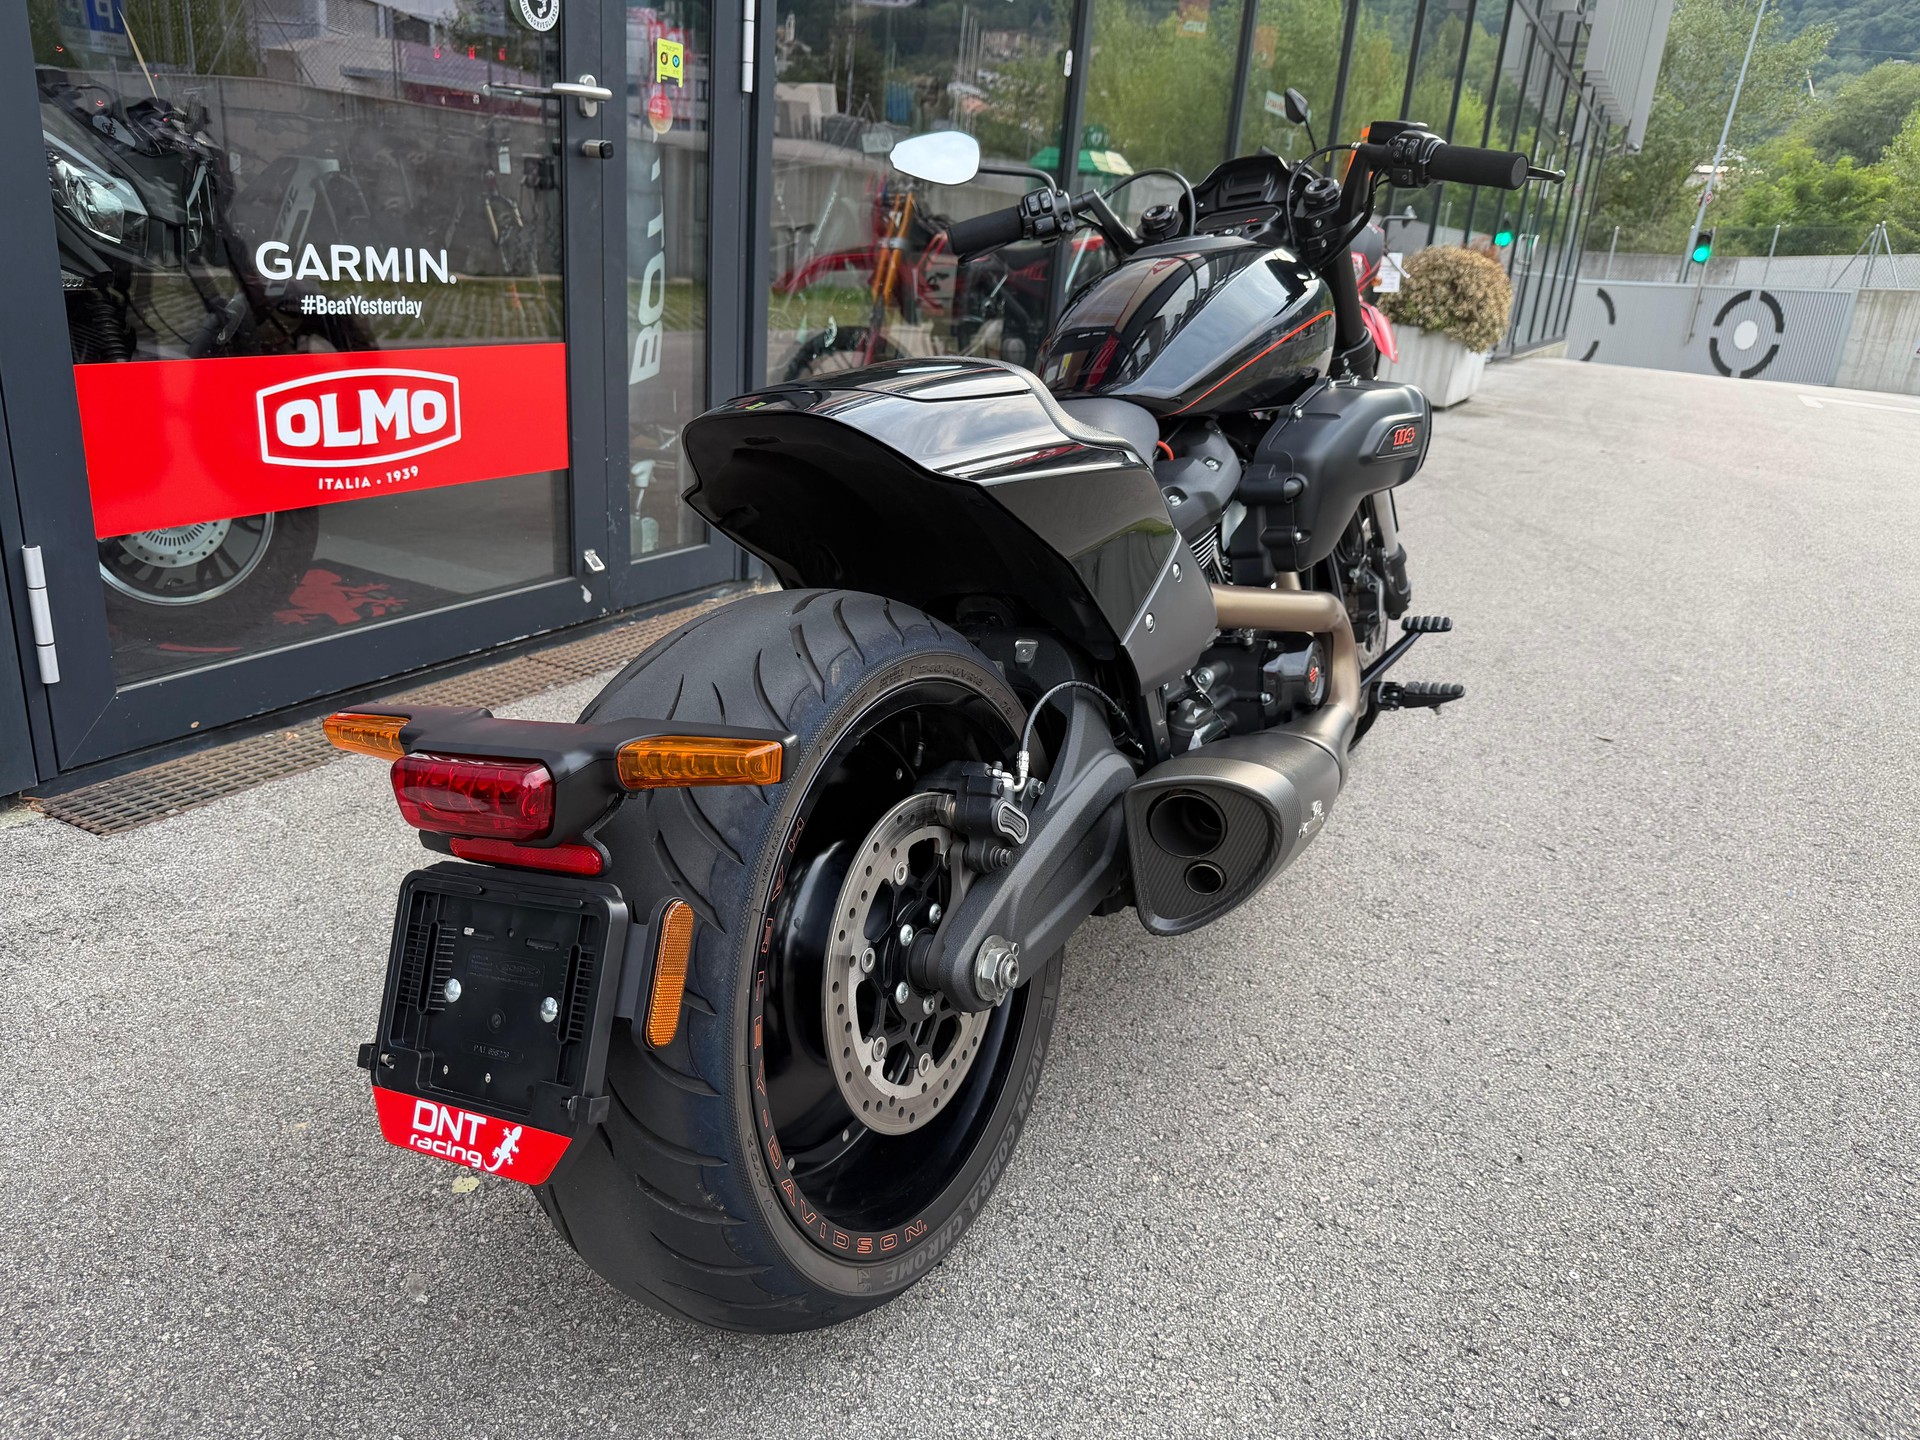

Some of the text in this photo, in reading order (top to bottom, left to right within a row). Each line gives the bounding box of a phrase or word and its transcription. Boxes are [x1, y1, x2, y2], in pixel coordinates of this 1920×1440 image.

[255, 241, 451, 284] GARMIN
[300, 294, 423, 319] #BeatYesterday
[275, 388, 448, 448] OLMO
[1393, 426, 1417, 447] 114
[318, 465, 419, 490] ITALIA 1939
[413, 1100, 486, 1145] DNT
[409, 1133, 483, 1168] racing
[883, 1034, 1044, 1287] AVON COBRA CHROME
